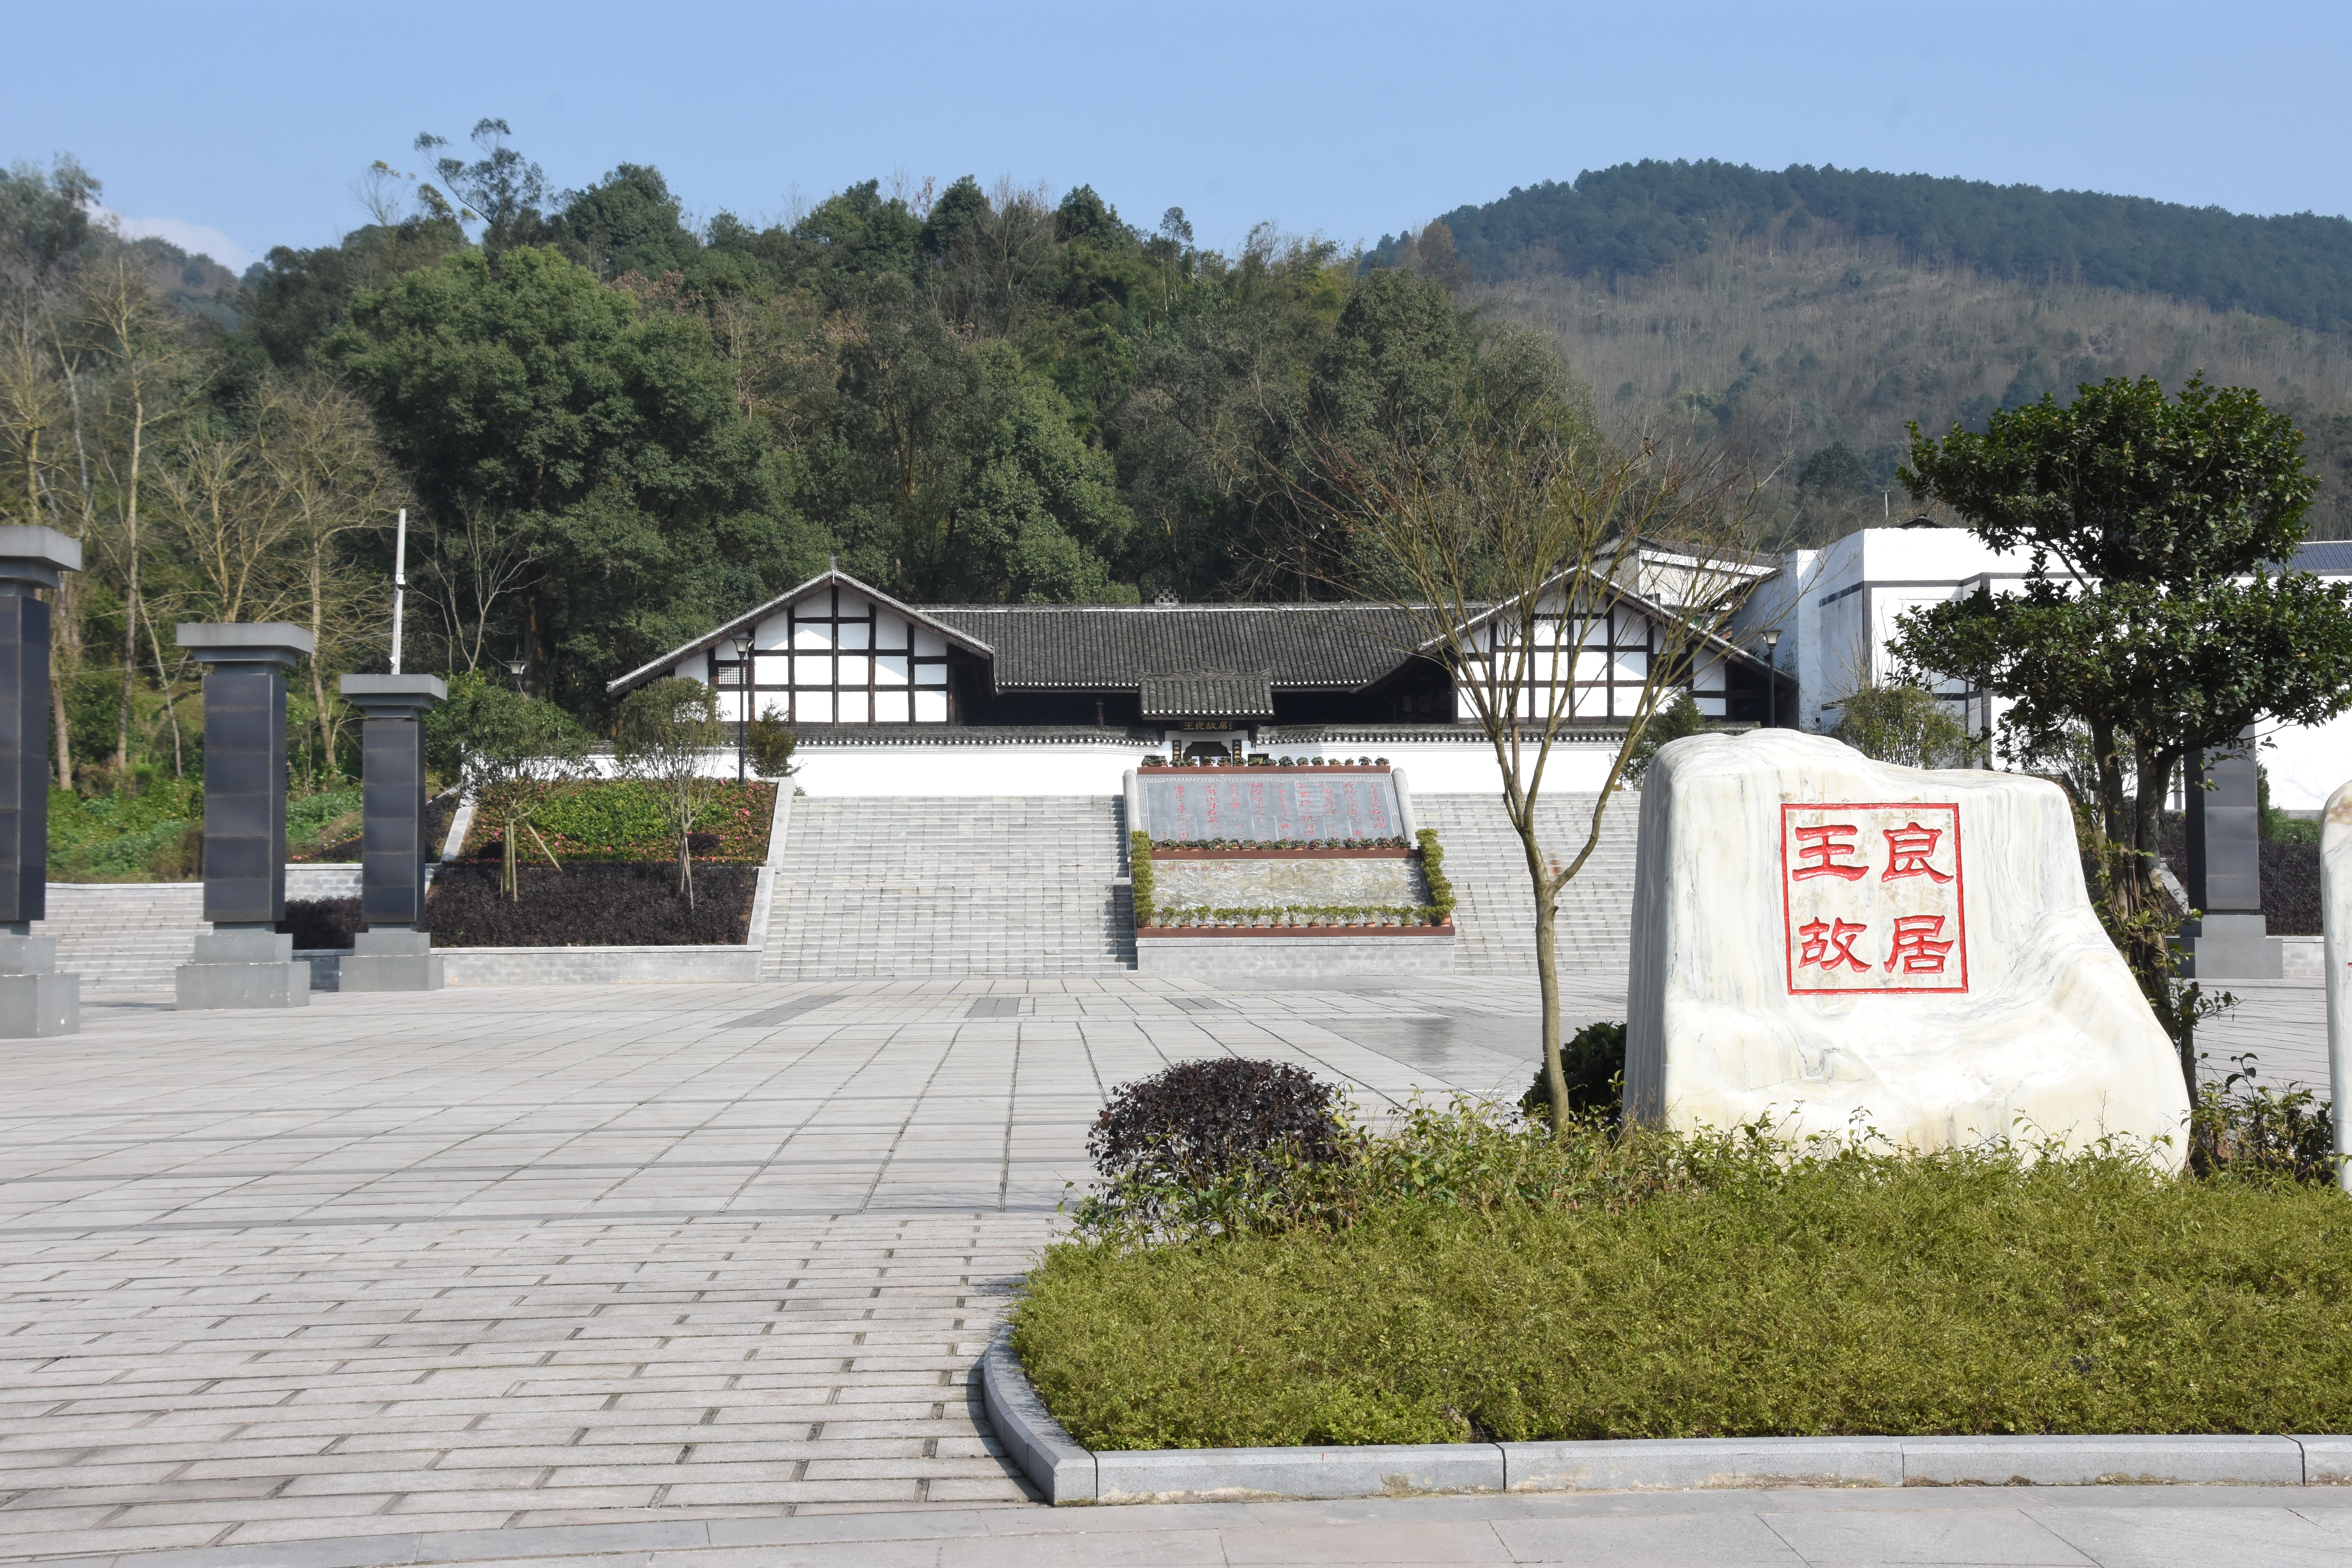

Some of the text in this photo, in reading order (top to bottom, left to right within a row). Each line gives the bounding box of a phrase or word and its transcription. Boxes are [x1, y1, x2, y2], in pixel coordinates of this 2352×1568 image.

[1183, 721, 1227, 730] 王良故居
[1792, 822, 1954, 884] 王良
[1798, 915, 1954, 975] 故居
